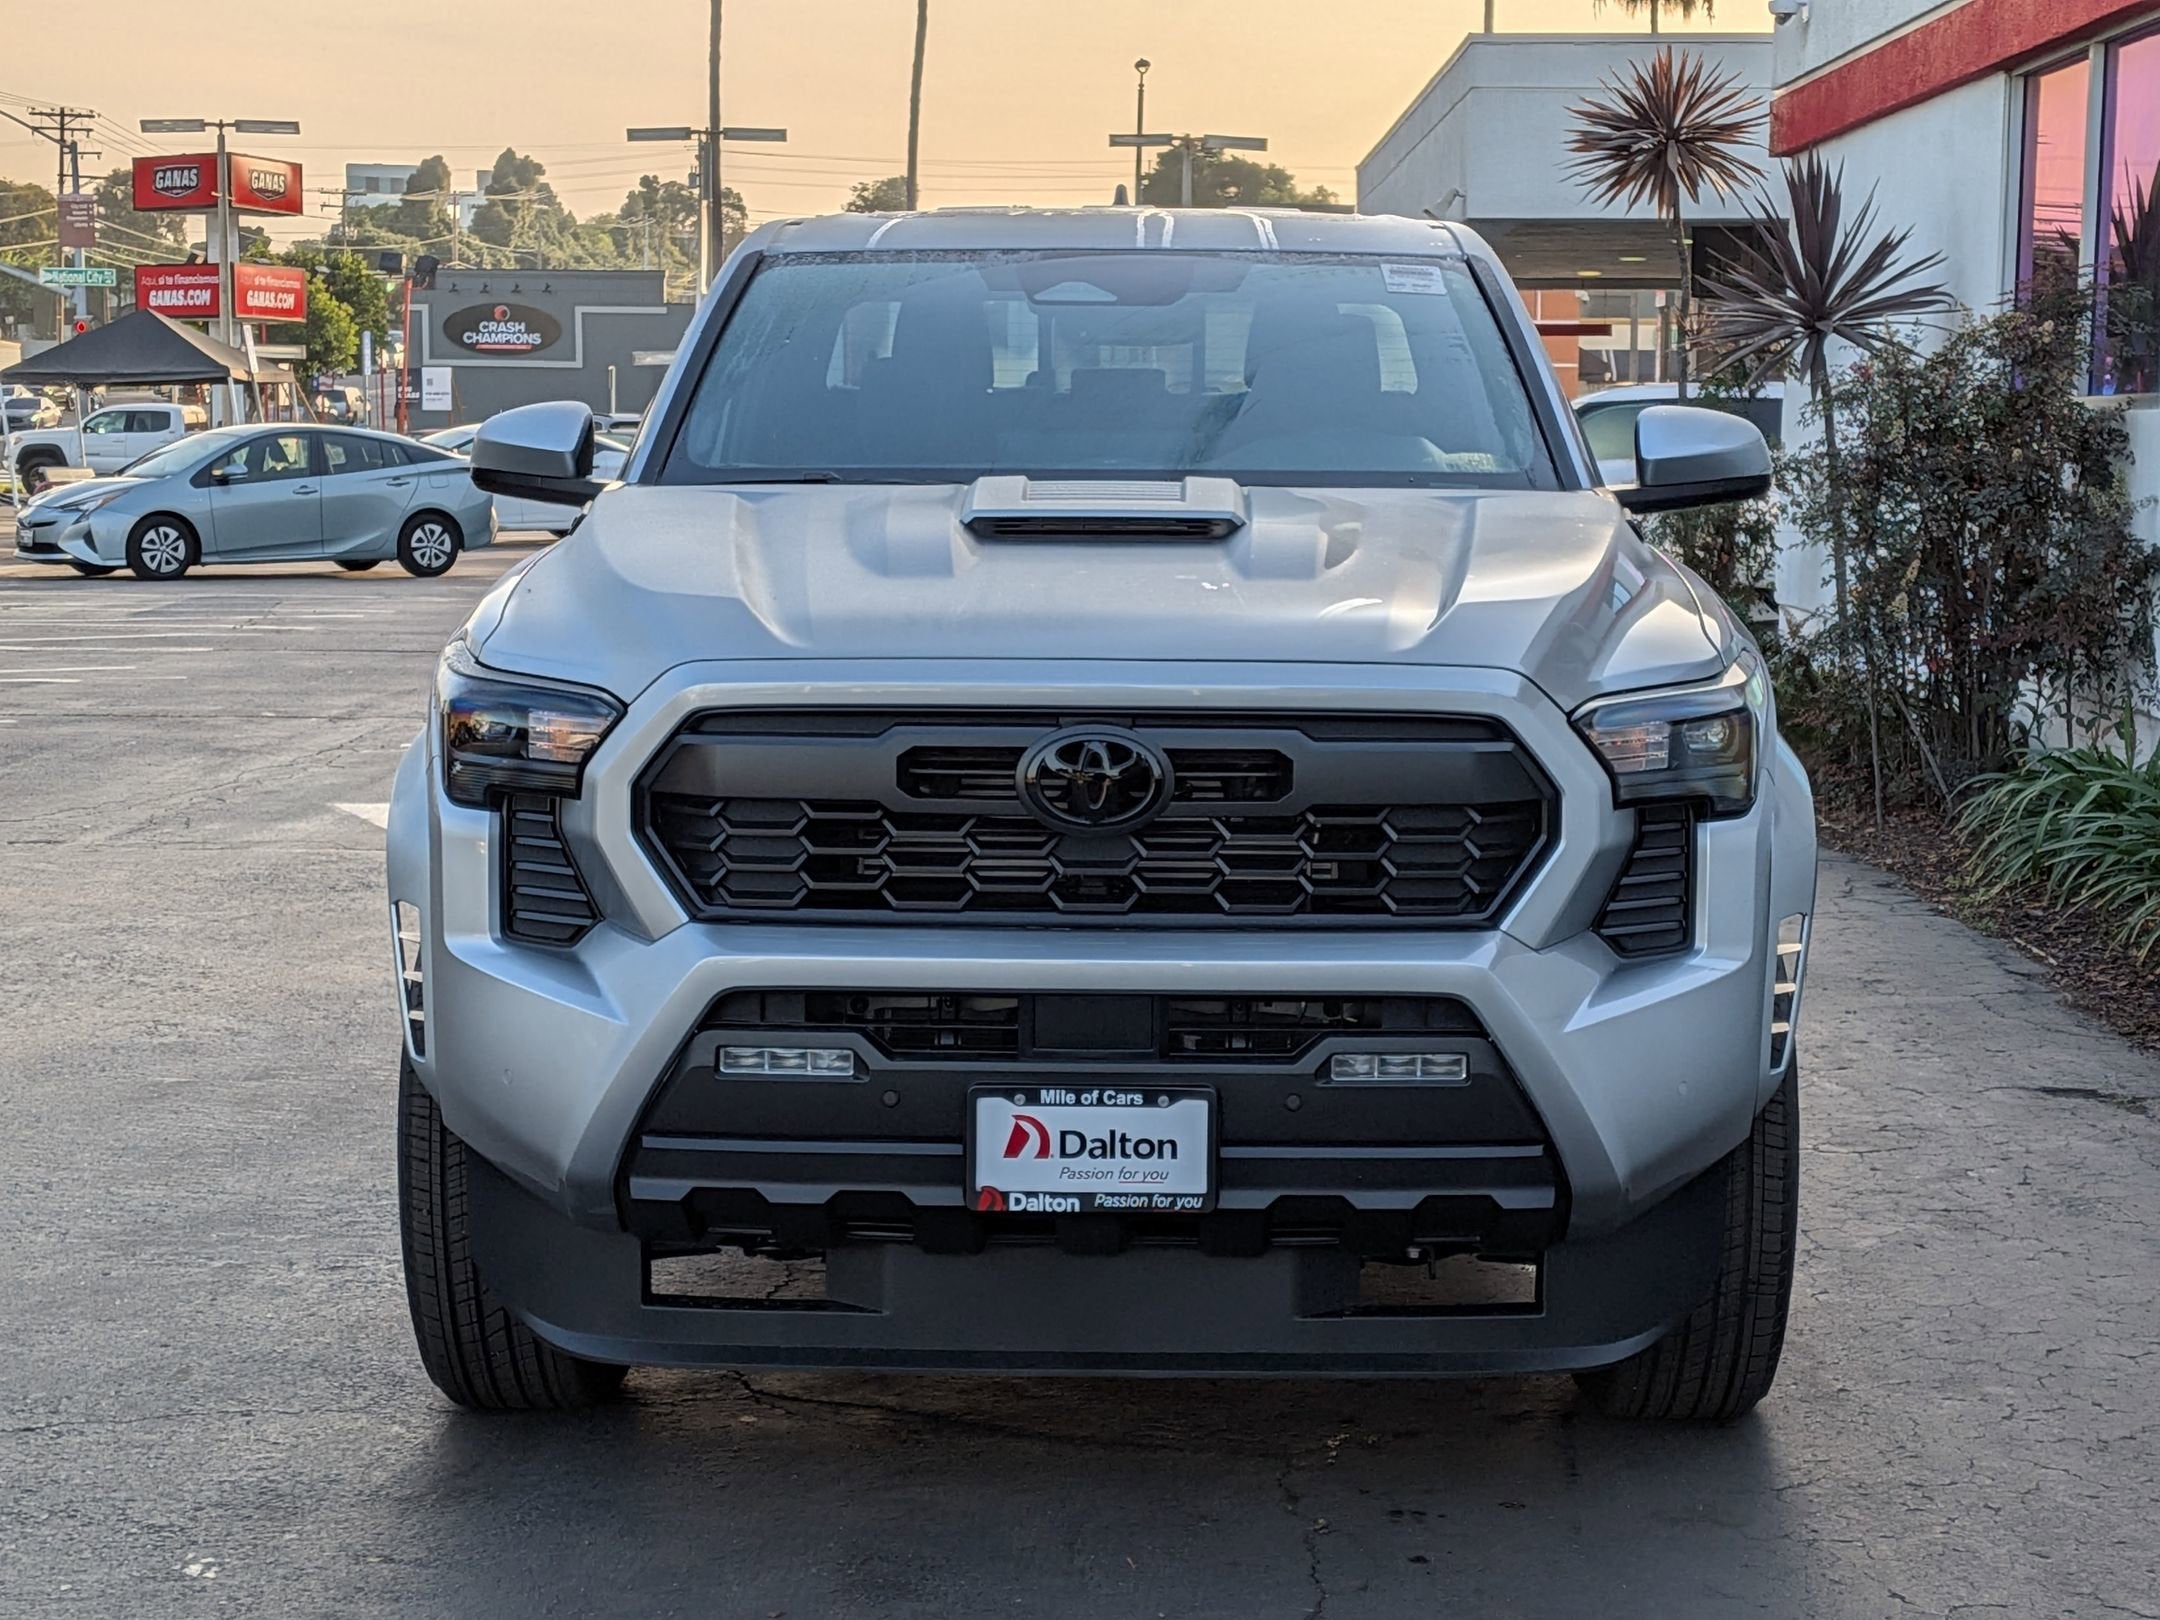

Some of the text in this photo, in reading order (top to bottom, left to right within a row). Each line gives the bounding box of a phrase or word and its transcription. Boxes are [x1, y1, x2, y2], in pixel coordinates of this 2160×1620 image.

[155, 168, 198, 189] GANAS
[251, 171, 285, 193] GANAS
[52, 270, 86, 283] National
[87, 270, 104, 284] City
[149, 288, 212, 307] GANAS.COM
[246, 289, 295, 310] GANAS.COM
[478, 320, 526, 333] CRASH
[462, 331, 542, 345] CHAMPIONS
[1040, 1089, 1144, 1106] Mile of Cars
[1059, 1129, 1178, 1160] Dalton
[1059, 1166, 1170, 1182] Passion for you
[1009, 1192, 1081, 1213] Dalton
[1094, 1193, 1204, 1211] Passion for you
